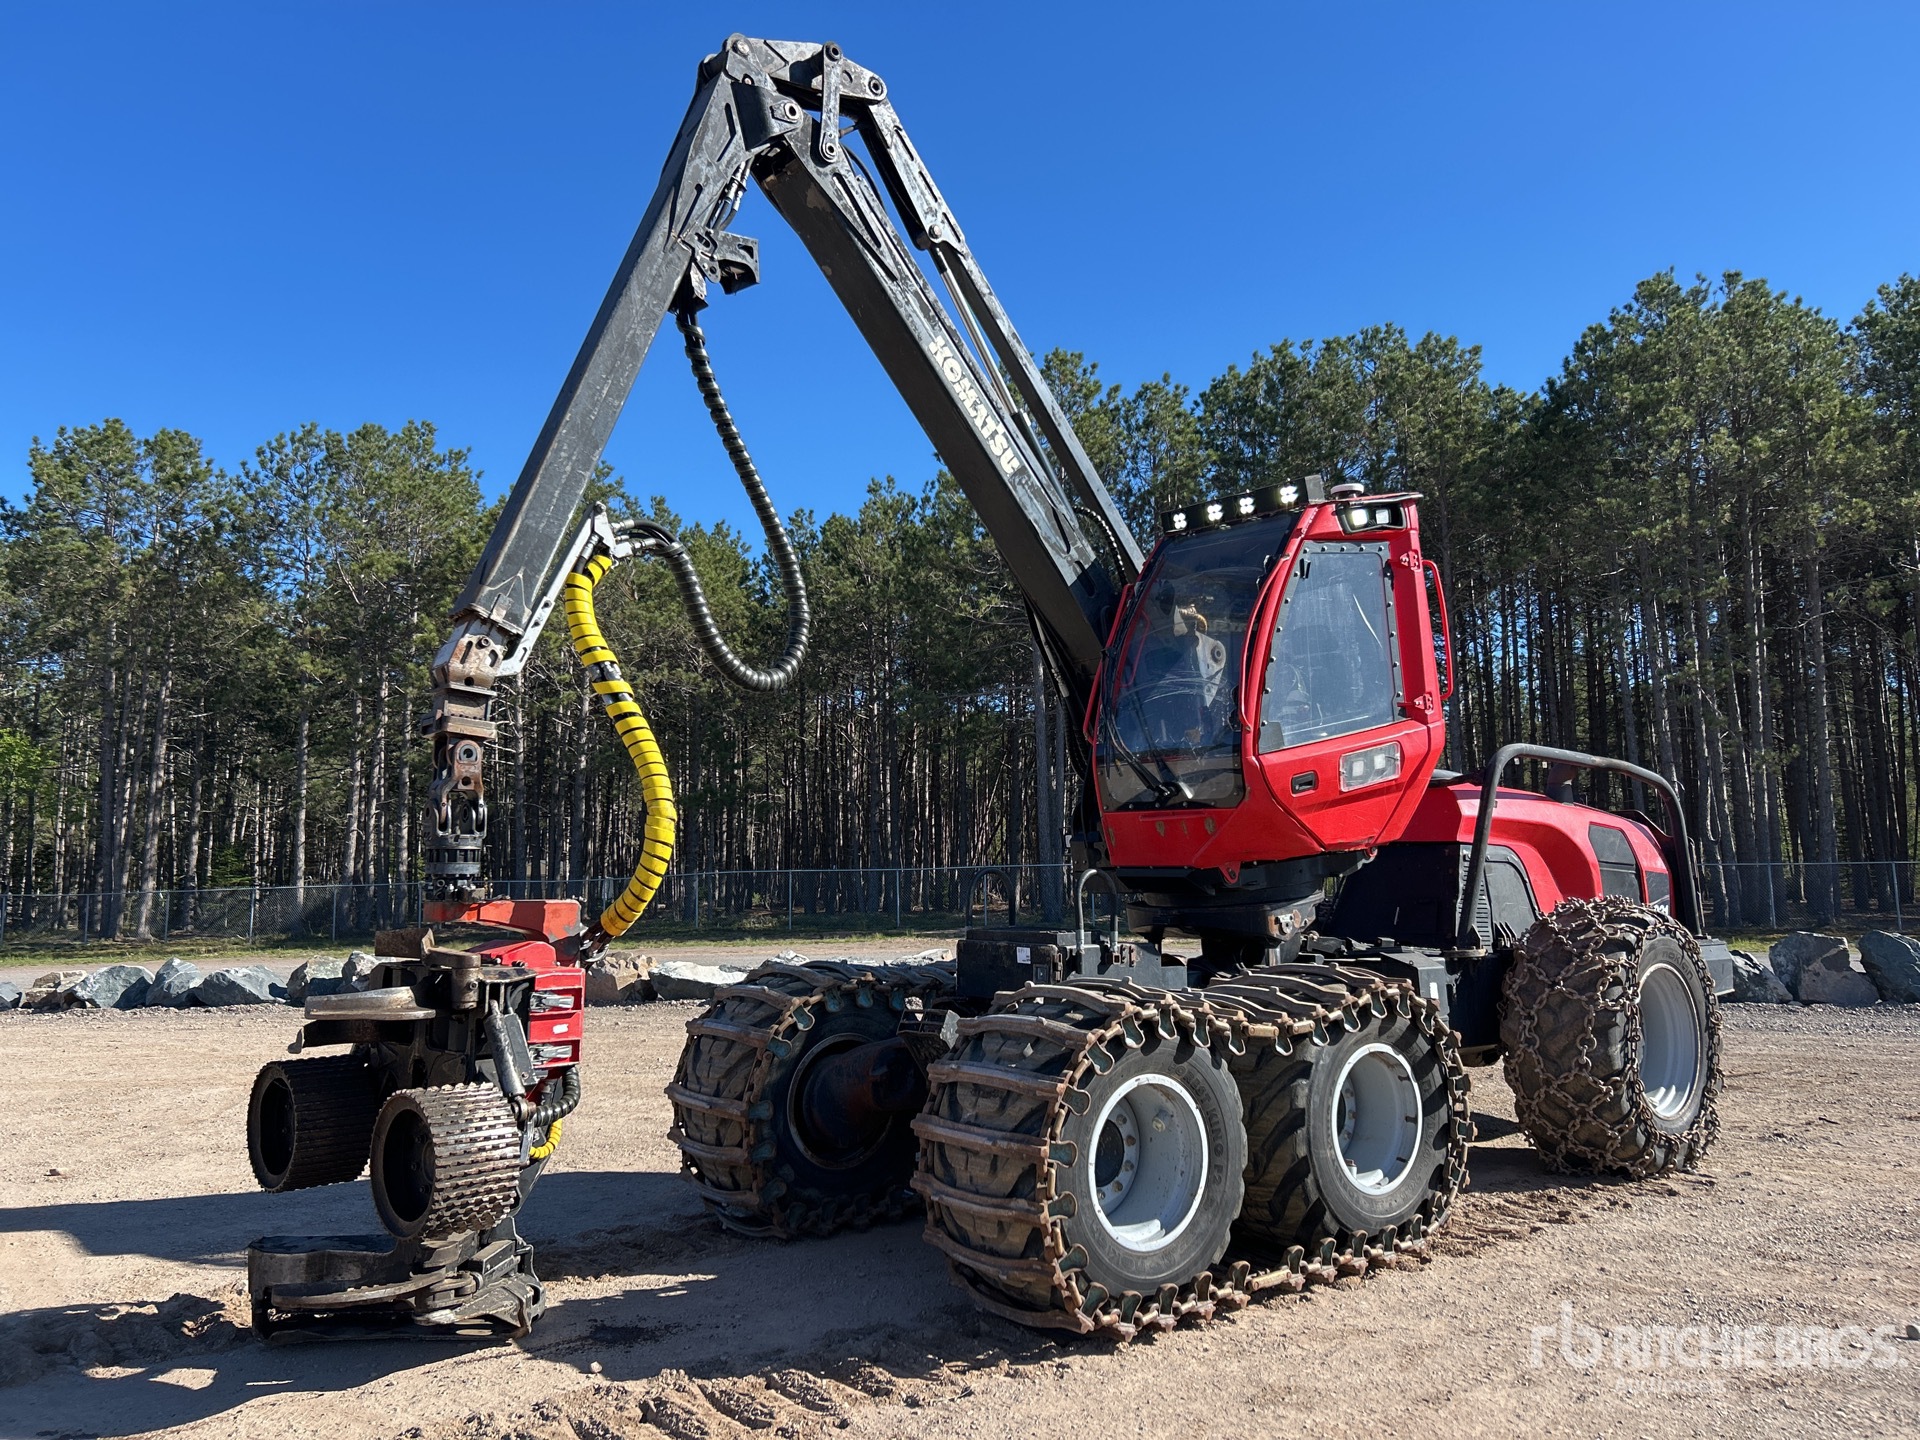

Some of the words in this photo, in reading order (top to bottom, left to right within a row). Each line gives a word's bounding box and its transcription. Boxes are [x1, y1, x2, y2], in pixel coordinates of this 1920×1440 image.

[928, 336, 1021, 474] KOMATSU
[1167, 1063, 1212, 1106] FOREST
[1206, 1107, 1224, 1157] KING
